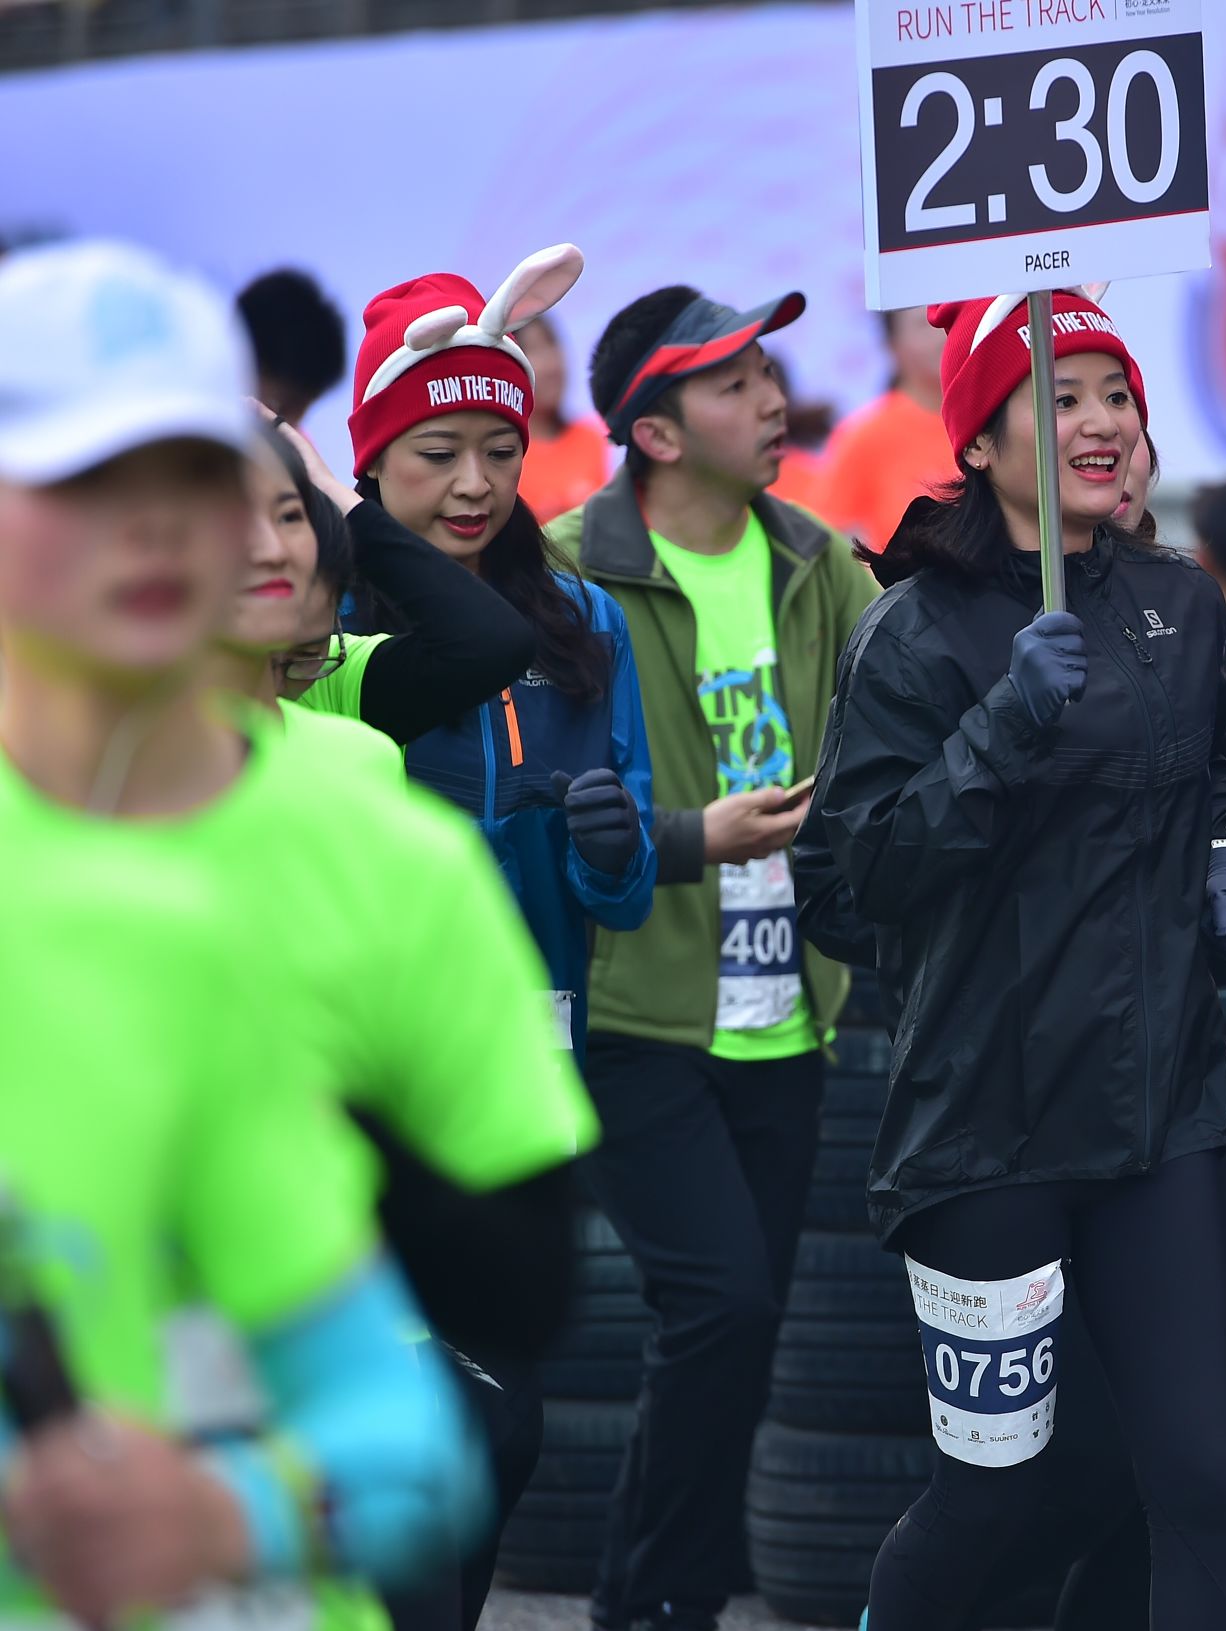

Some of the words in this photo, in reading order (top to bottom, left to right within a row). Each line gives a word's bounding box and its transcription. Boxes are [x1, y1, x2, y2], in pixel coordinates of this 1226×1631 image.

[898, 6, 953, 41] RUN
[961, 0, 1014, 34] THE
[1026, 0, 1105, 27] TRACK
[899, 49, 1181, 234] 2:30
[1025, 250, 1071, 273] PACER
[1052, 311, 1088, 334] THE
[427, 376, 462, 407] RUN
[461, 375, 493, 400] THE
[492, 378, 524, 416] TRACK
[913, 1273, 987, 1309] 蒸蒸日上迎新跑
[917, 1293, 938, 1317] THE
[941, 1304, 988, 1329] TRACK
[935, 1336, 1054, 1398] 0756
[989, 1433, 1019, 1443] SUUNTO
